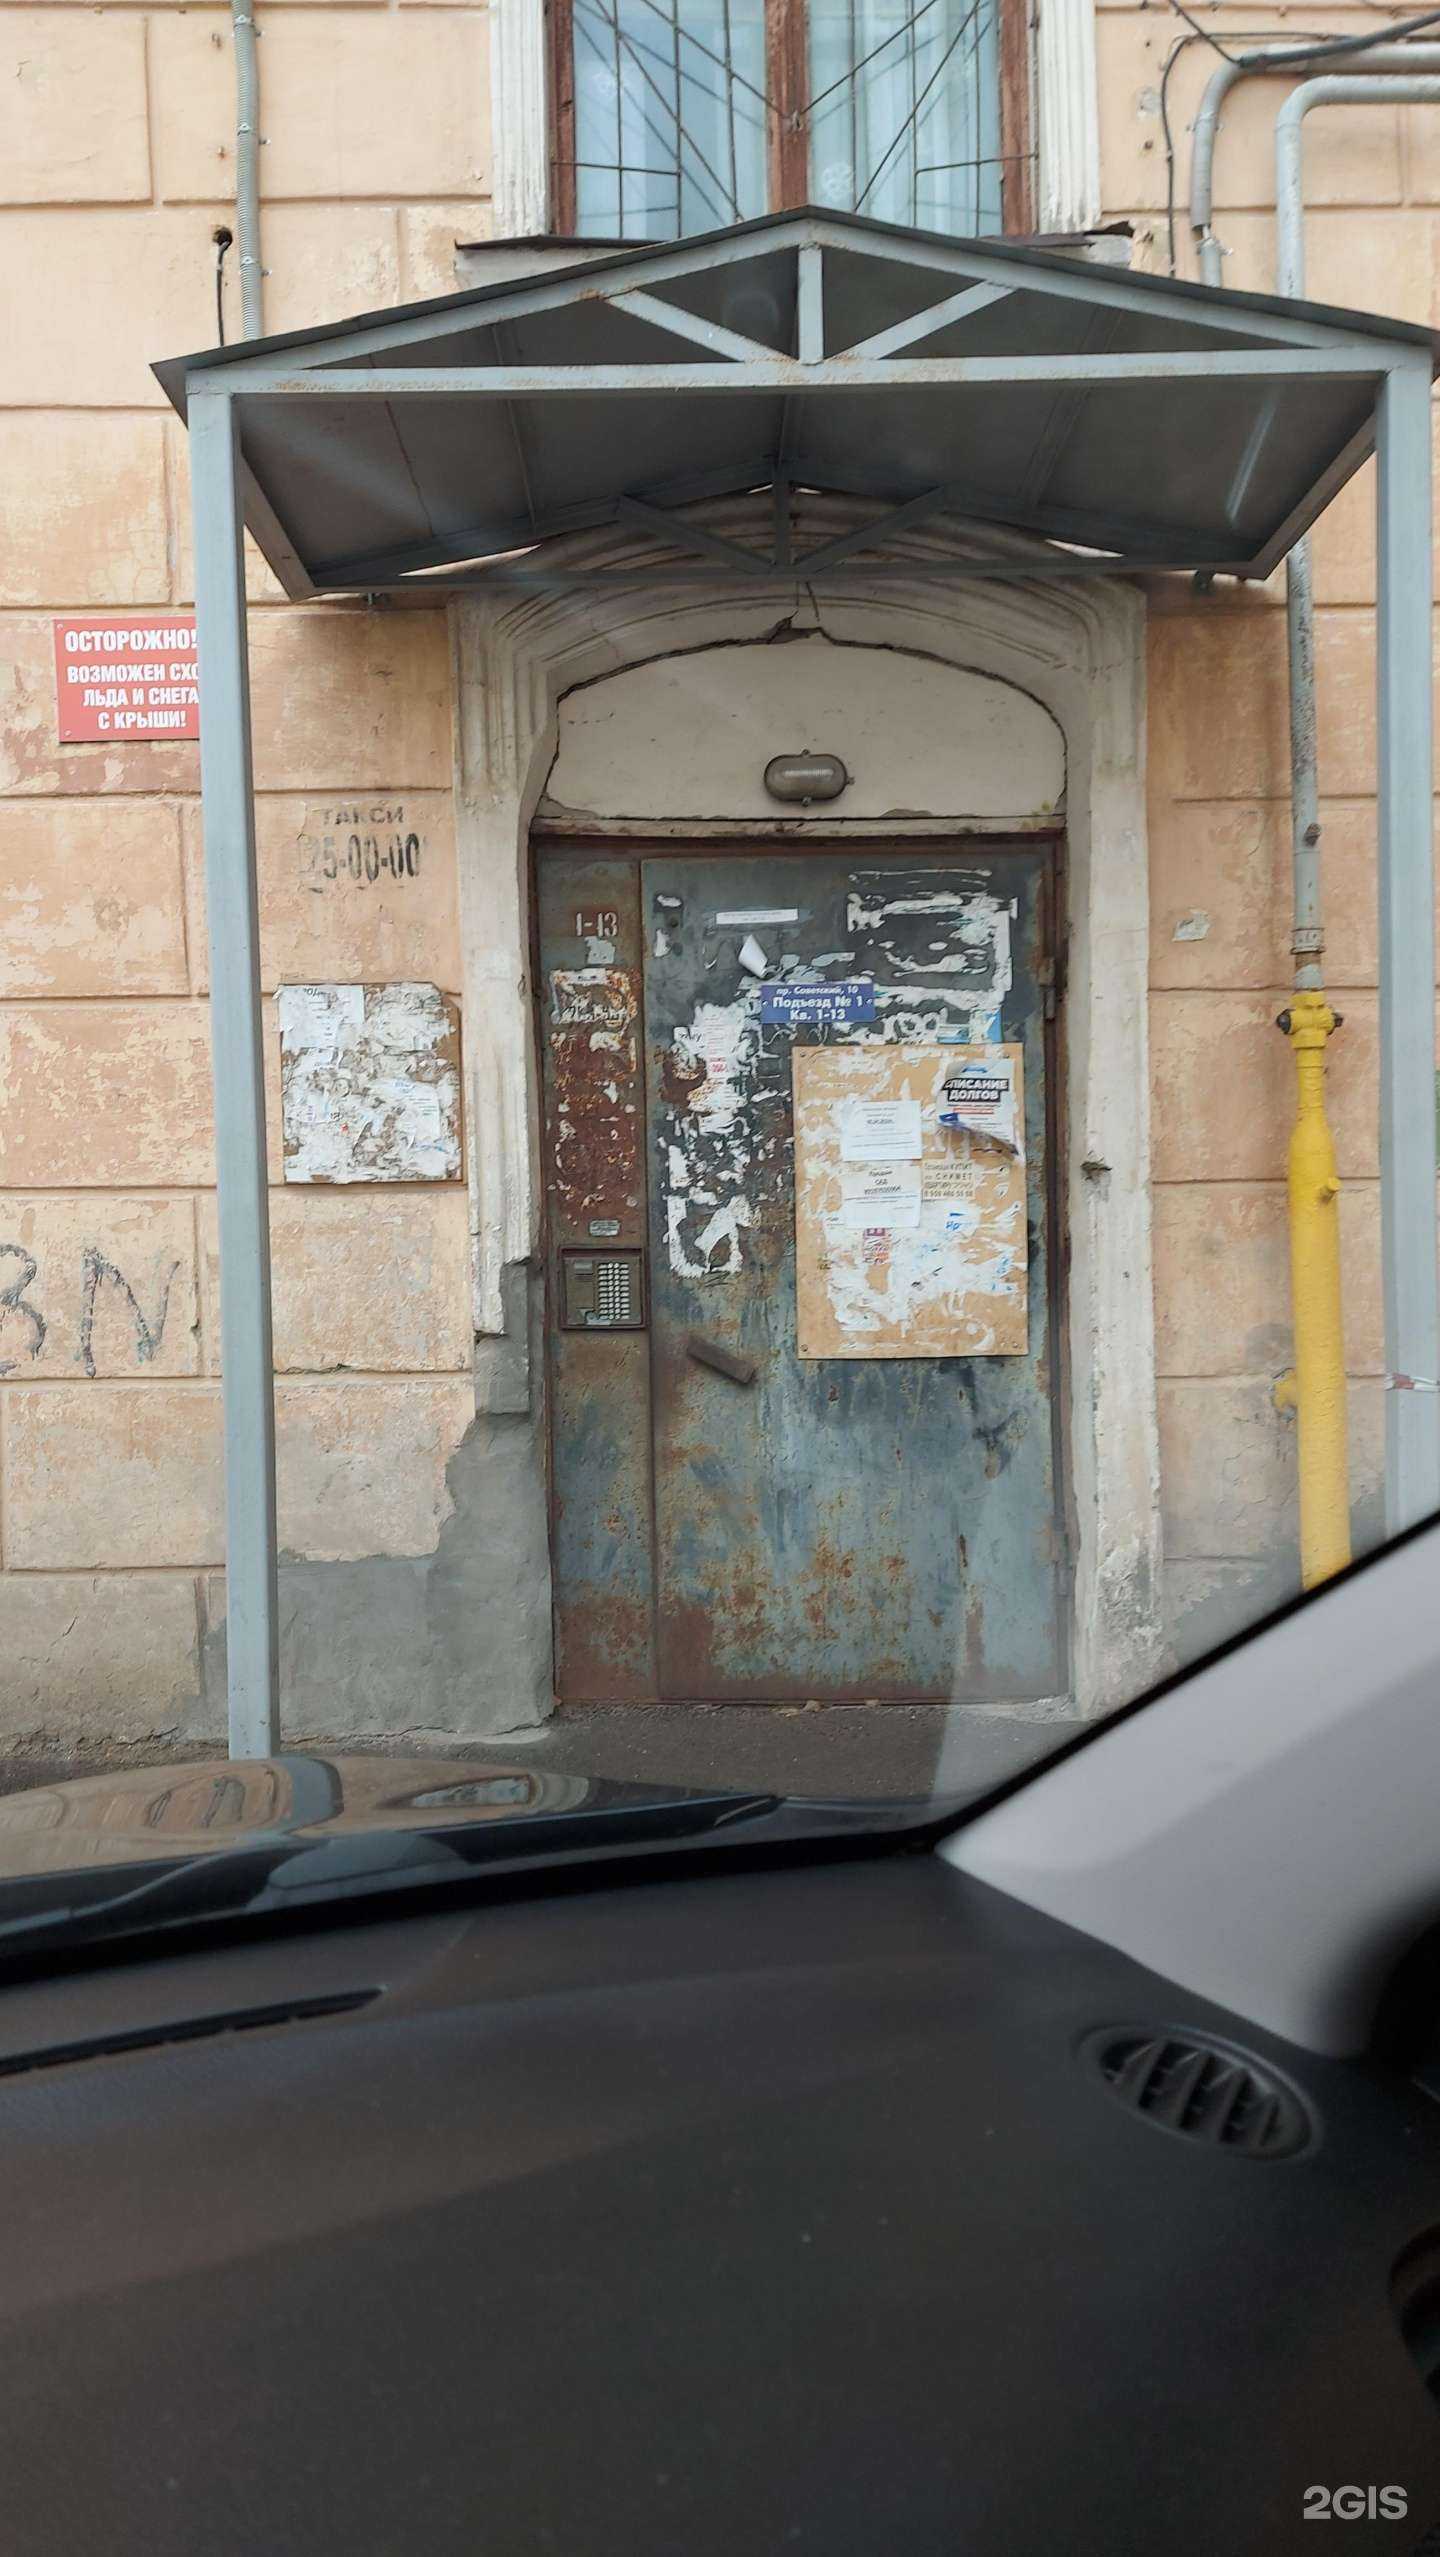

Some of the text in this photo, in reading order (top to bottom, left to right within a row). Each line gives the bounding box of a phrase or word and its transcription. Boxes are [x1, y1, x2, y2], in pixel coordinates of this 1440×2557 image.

[64, 628, 198, 652] ОСТОРОЖНО!
[67, 662, 200, 683] ВОЗМОЖЕН СХО
[83, 687, 199, 707] ЛЬДА И СНЕГА
[98, 710, 187, 729] С КРЫШИ!
[575, 912, 618, 937] 1-13
[847, 985, 859, 994] 10
[773, 995, 863, 1009] Подъезд № 1
[790, 1008, 846, 1020] Кв. 1-13
[949, 1089, 999, 1101] ДОЛГОВ
